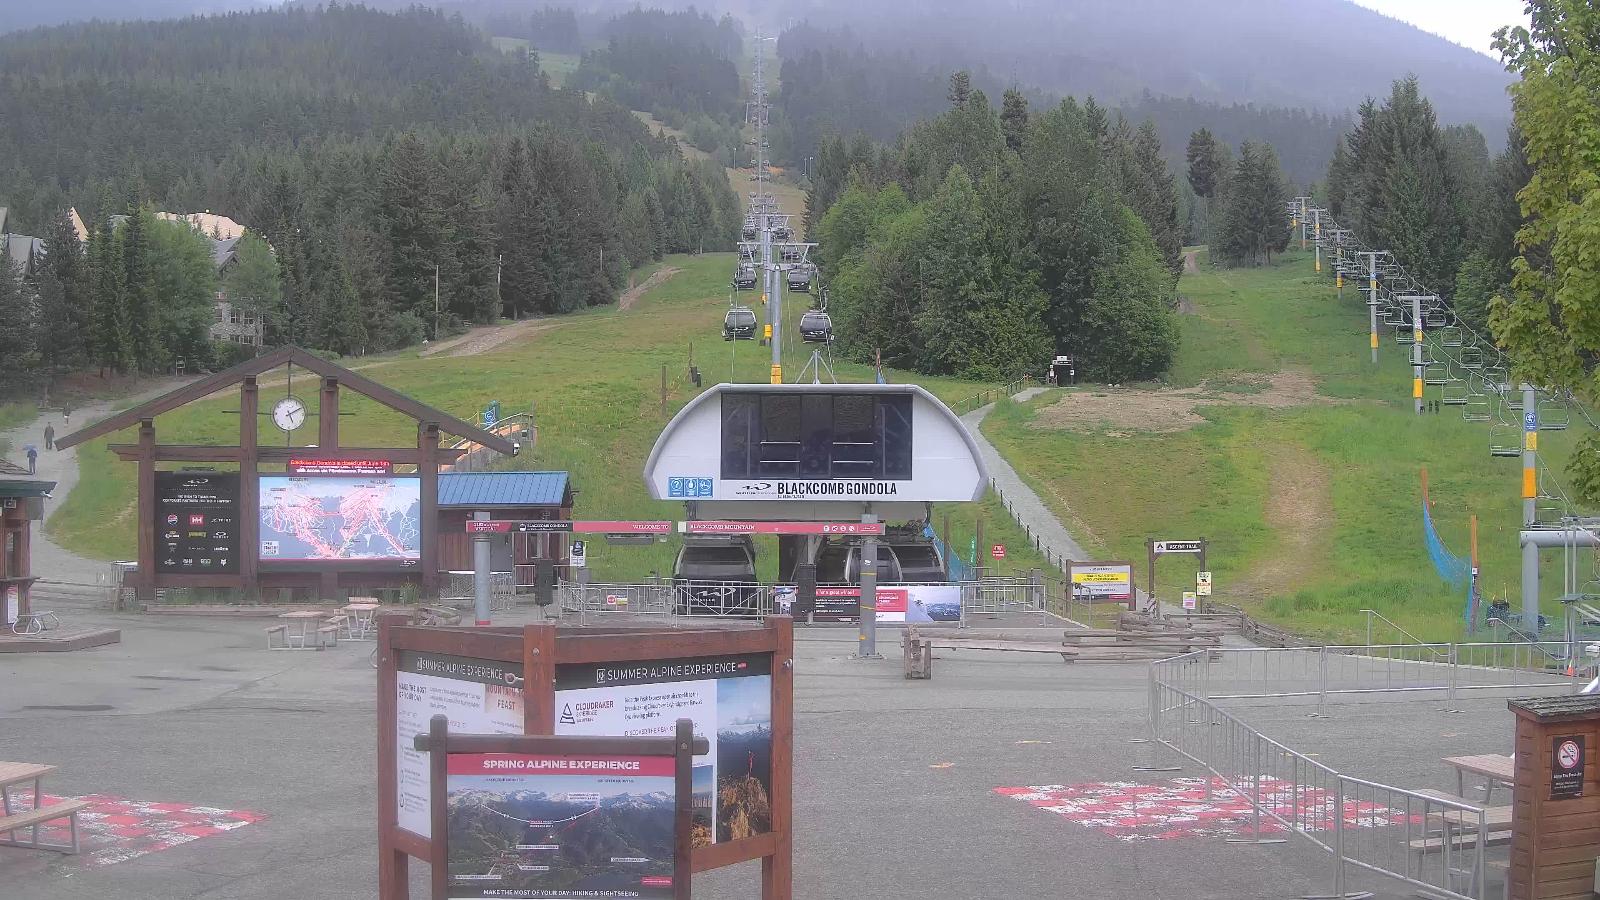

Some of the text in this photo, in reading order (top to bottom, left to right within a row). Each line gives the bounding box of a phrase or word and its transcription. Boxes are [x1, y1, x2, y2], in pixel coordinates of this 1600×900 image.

[777, 482, 897, 495] BLACKCOMB GONDOLA
[422, 659, 503, 680] SUMMER ALPINE EXPERIENCE
[607, 662, 736, 681] SUMMER ALPINE EXPERIENCE
[497, 699, 516, 710] FEAST
[575, 700, 614, 711] CLOUDRAKER
[483, 760, 640, 770] SPRING ALPINE EXPERIENCE
